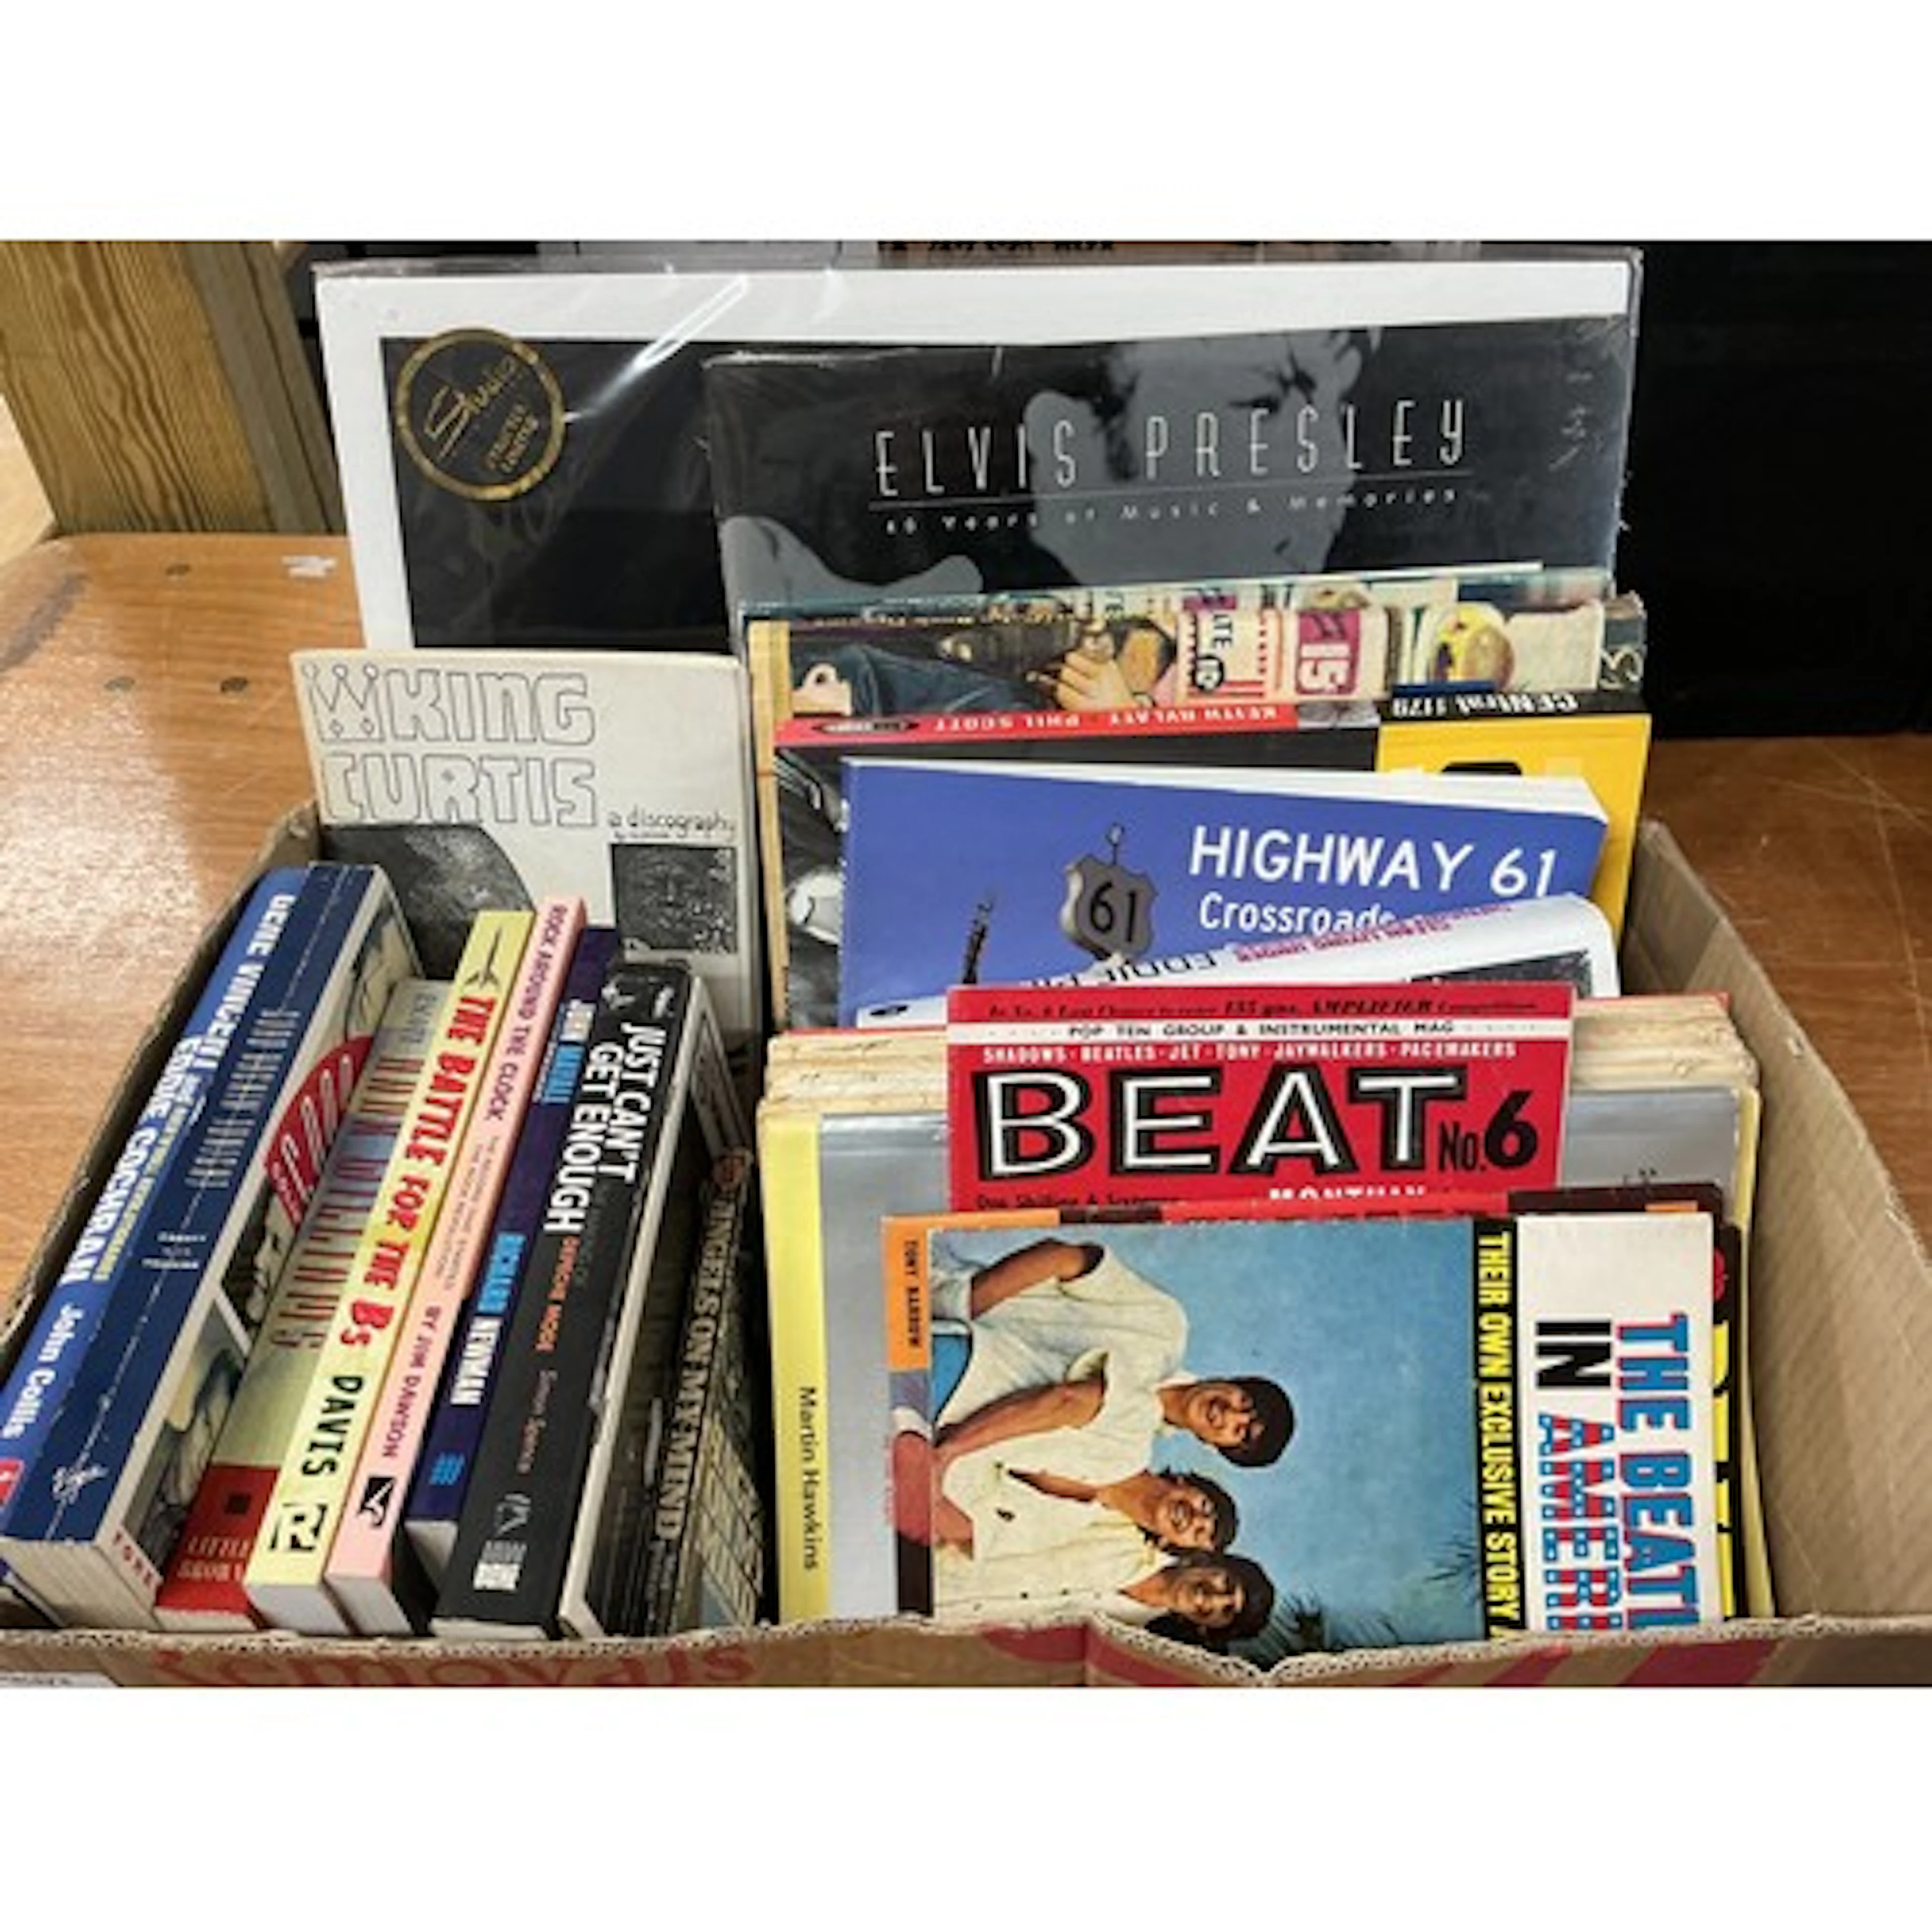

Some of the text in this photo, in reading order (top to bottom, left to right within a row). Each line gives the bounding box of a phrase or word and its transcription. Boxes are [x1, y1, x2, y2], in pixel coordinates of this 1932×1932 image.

[874, 399, 1466, 497] ELVIS PRESLEY
[385, 667, 596, 746] KING
[320, 752, 597, 828] CURTIS
[1187, 824, 1557, 898] HIGHWAY 61
[248, 894, 297, 966] GENE
[541, 905, 569, 952] ROCK
[1089, 880, 1138, 944] 61
[200, 960, 265, 1071] VINCENT
[445, 996, 497, 1044] THE
[517, 952, 554, 1021] AROUND
[505, 1023, 532, 1059] THE
[1068, 1025, 1104, 1039] POP
[1115, 1024, 1151, 1037] TEN
[1162, 1023, 1224, 1036] GROUP
[1259, 1022, 1402, 1036] INSTRUMENTAL
[1413, 1020, 1456, 1033] MAG
[1079, 1045, 1157, 1063] BEATLES
[1401, 1041, 1517, 1058] PACEMAKERS
[139, 1036, 202, 1119] EDDIE
[485, 1062, 520, 1122] CLOCK
[581, 1042, 624, 1098] GET
[599, 1021, 667, 1184] JUST CAN'T
[405, 1052, 476, 1166] BATTLE
[972, 1062, 1466, 1180] BEAT
[60, 1126, 158, 1284] COCHRAN
[386, 1175, 432, 1234] FOR
[543, 1103, 610, 1235] ENOUGH
[363, 1239, 410, 1289] THE
[1479, 1230, 1510, 1305] THEIR
[38, 1303, 84, 1365] John
[450, 1231, 526, 1406] RICHARD NEWMAN
[1479, 1311, 1512, 1379] OWN
[1536, 1320, 1612, 1389] IN
[2, 1369, 56, 1440] Collis
[382, 1305, 442, 1459] BY JIM DAWSON
[1616, 1312, 1689, 1433] THE
[302, 1375, 363, 1477] DAVIS
[1480, 1385, 1516, 1528] EXCLUSIVE
[653, 1416, 703, 1543] MIND
[799, 1386, 819, 1571] Martin Hawkins
[1484, 1531, 1520, 1629] STORY
